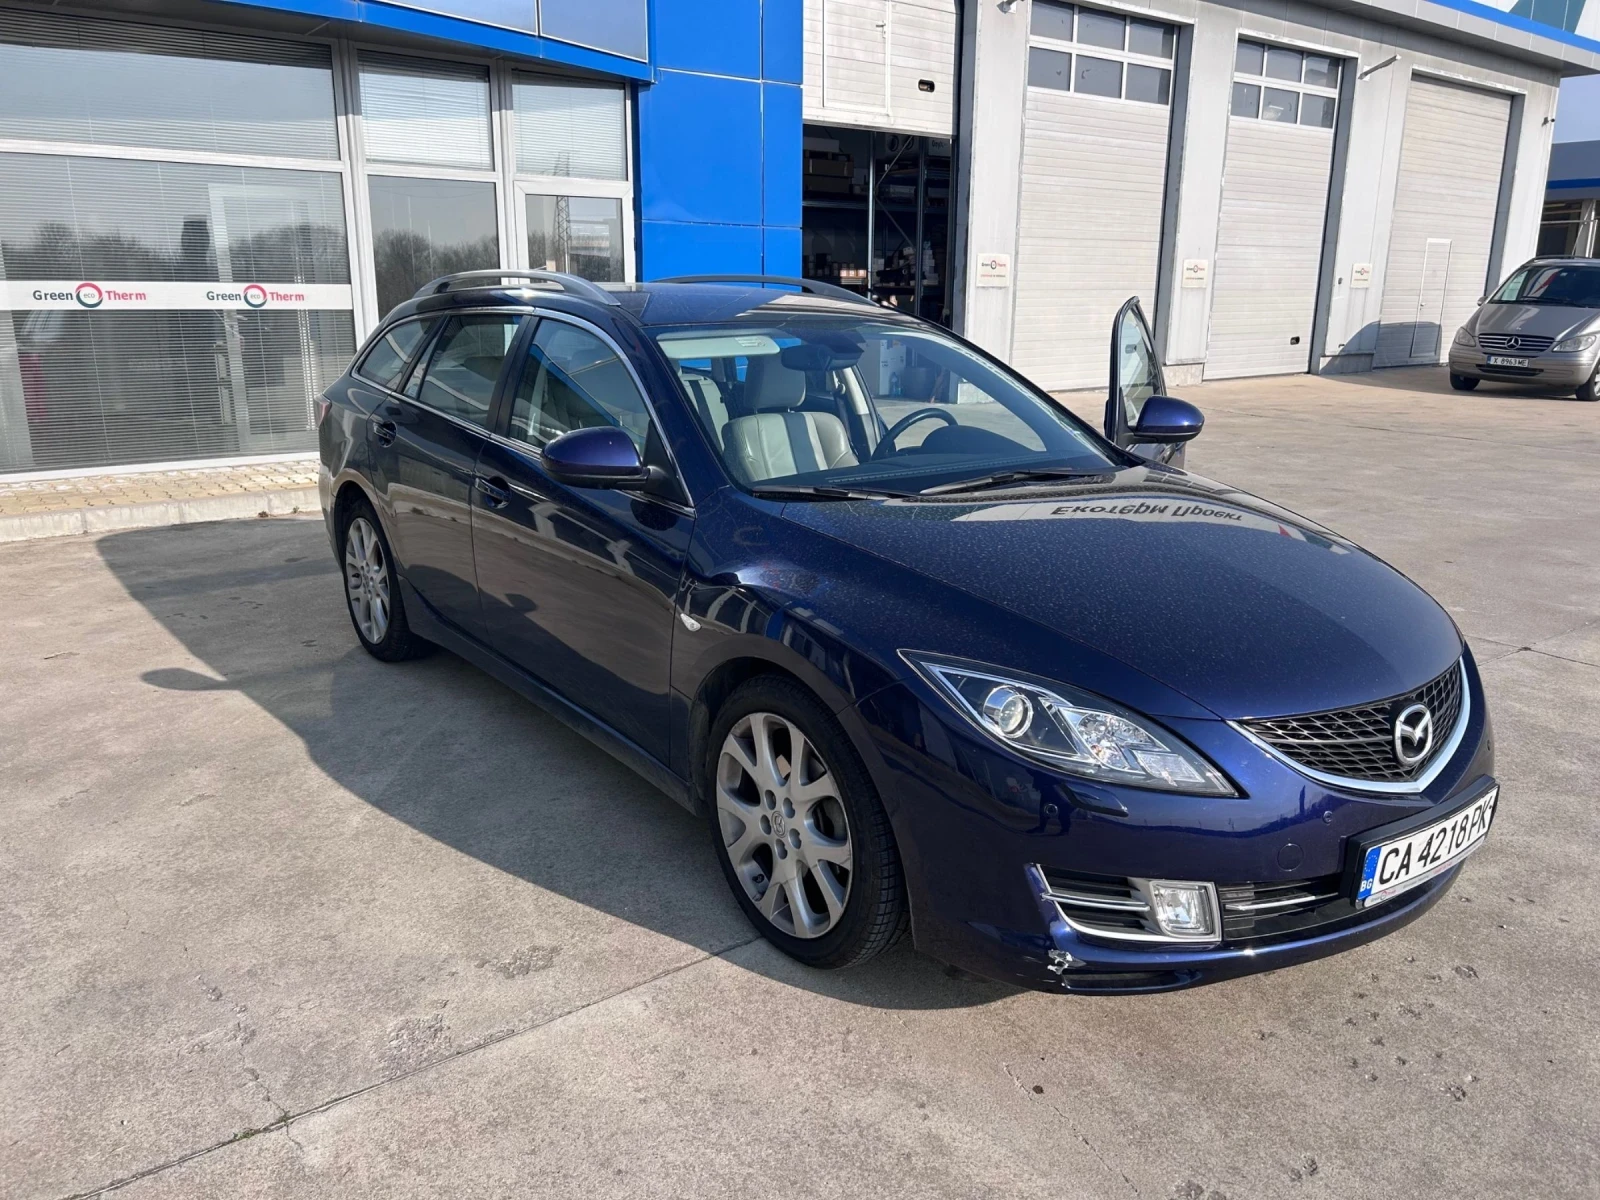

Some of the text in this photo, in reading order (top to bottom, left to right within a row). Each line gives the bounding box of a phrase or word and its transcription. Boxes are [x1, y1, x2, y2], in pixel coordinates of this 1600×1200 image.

[32, 290, 74, 301] Green
[105, 290, 147, 301] Therm
[206, 290, 242, 301] Green
[269, 291, 305, 302] Therm
[1379, 841, 1413, 885] CA
[1360, 878, 1373, 892] BG
